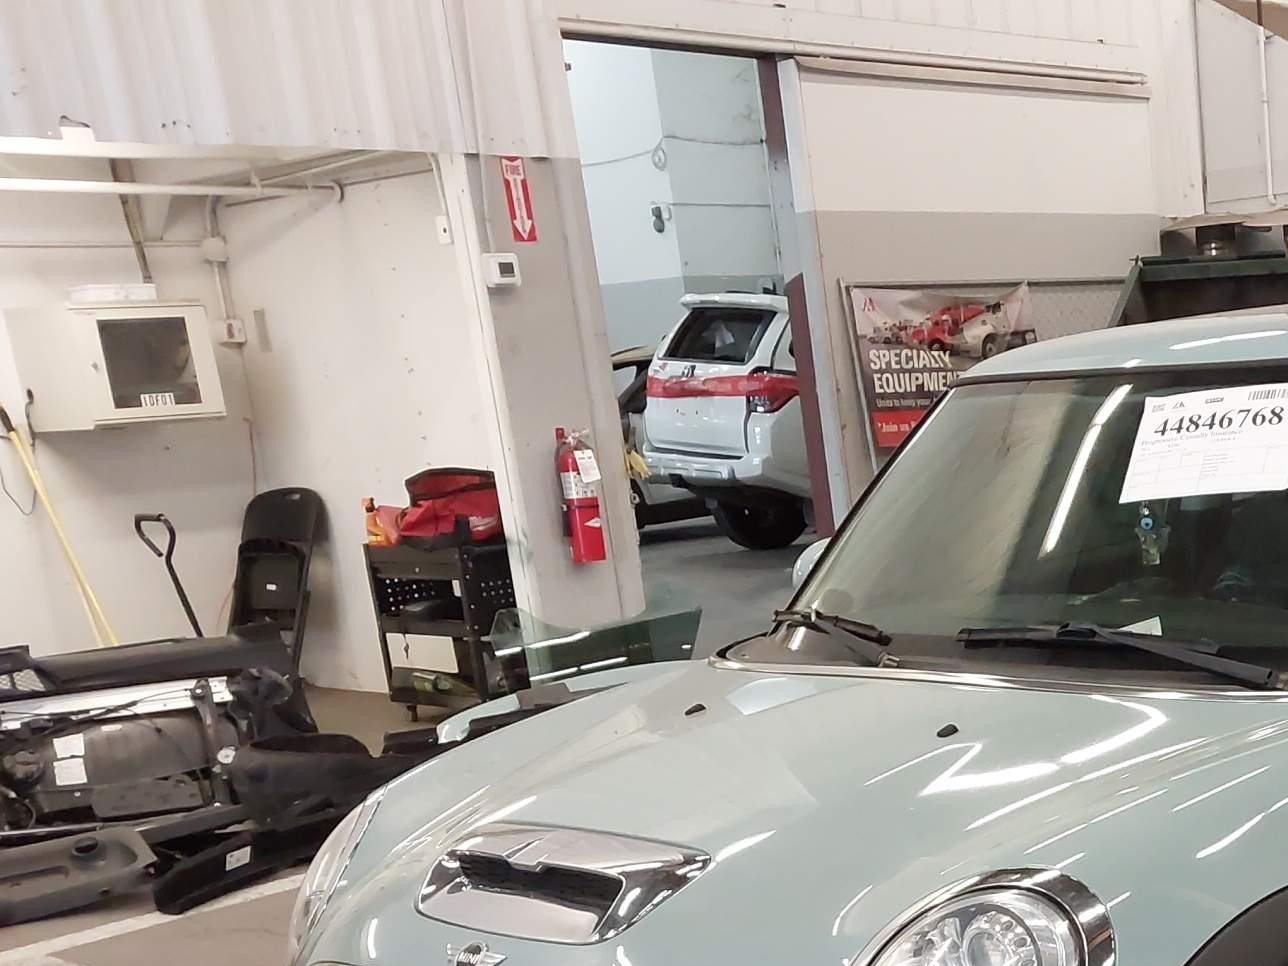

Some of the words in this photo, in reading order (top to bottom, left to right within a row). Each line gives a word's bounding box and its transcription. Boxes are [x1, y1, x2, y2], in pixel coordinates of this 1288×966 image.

[869, 349, 952, 370] SPECIALTY
[873, 371, 963, 393] EQUIPMEN
[1153, 405, 1285, 437] 44846768
